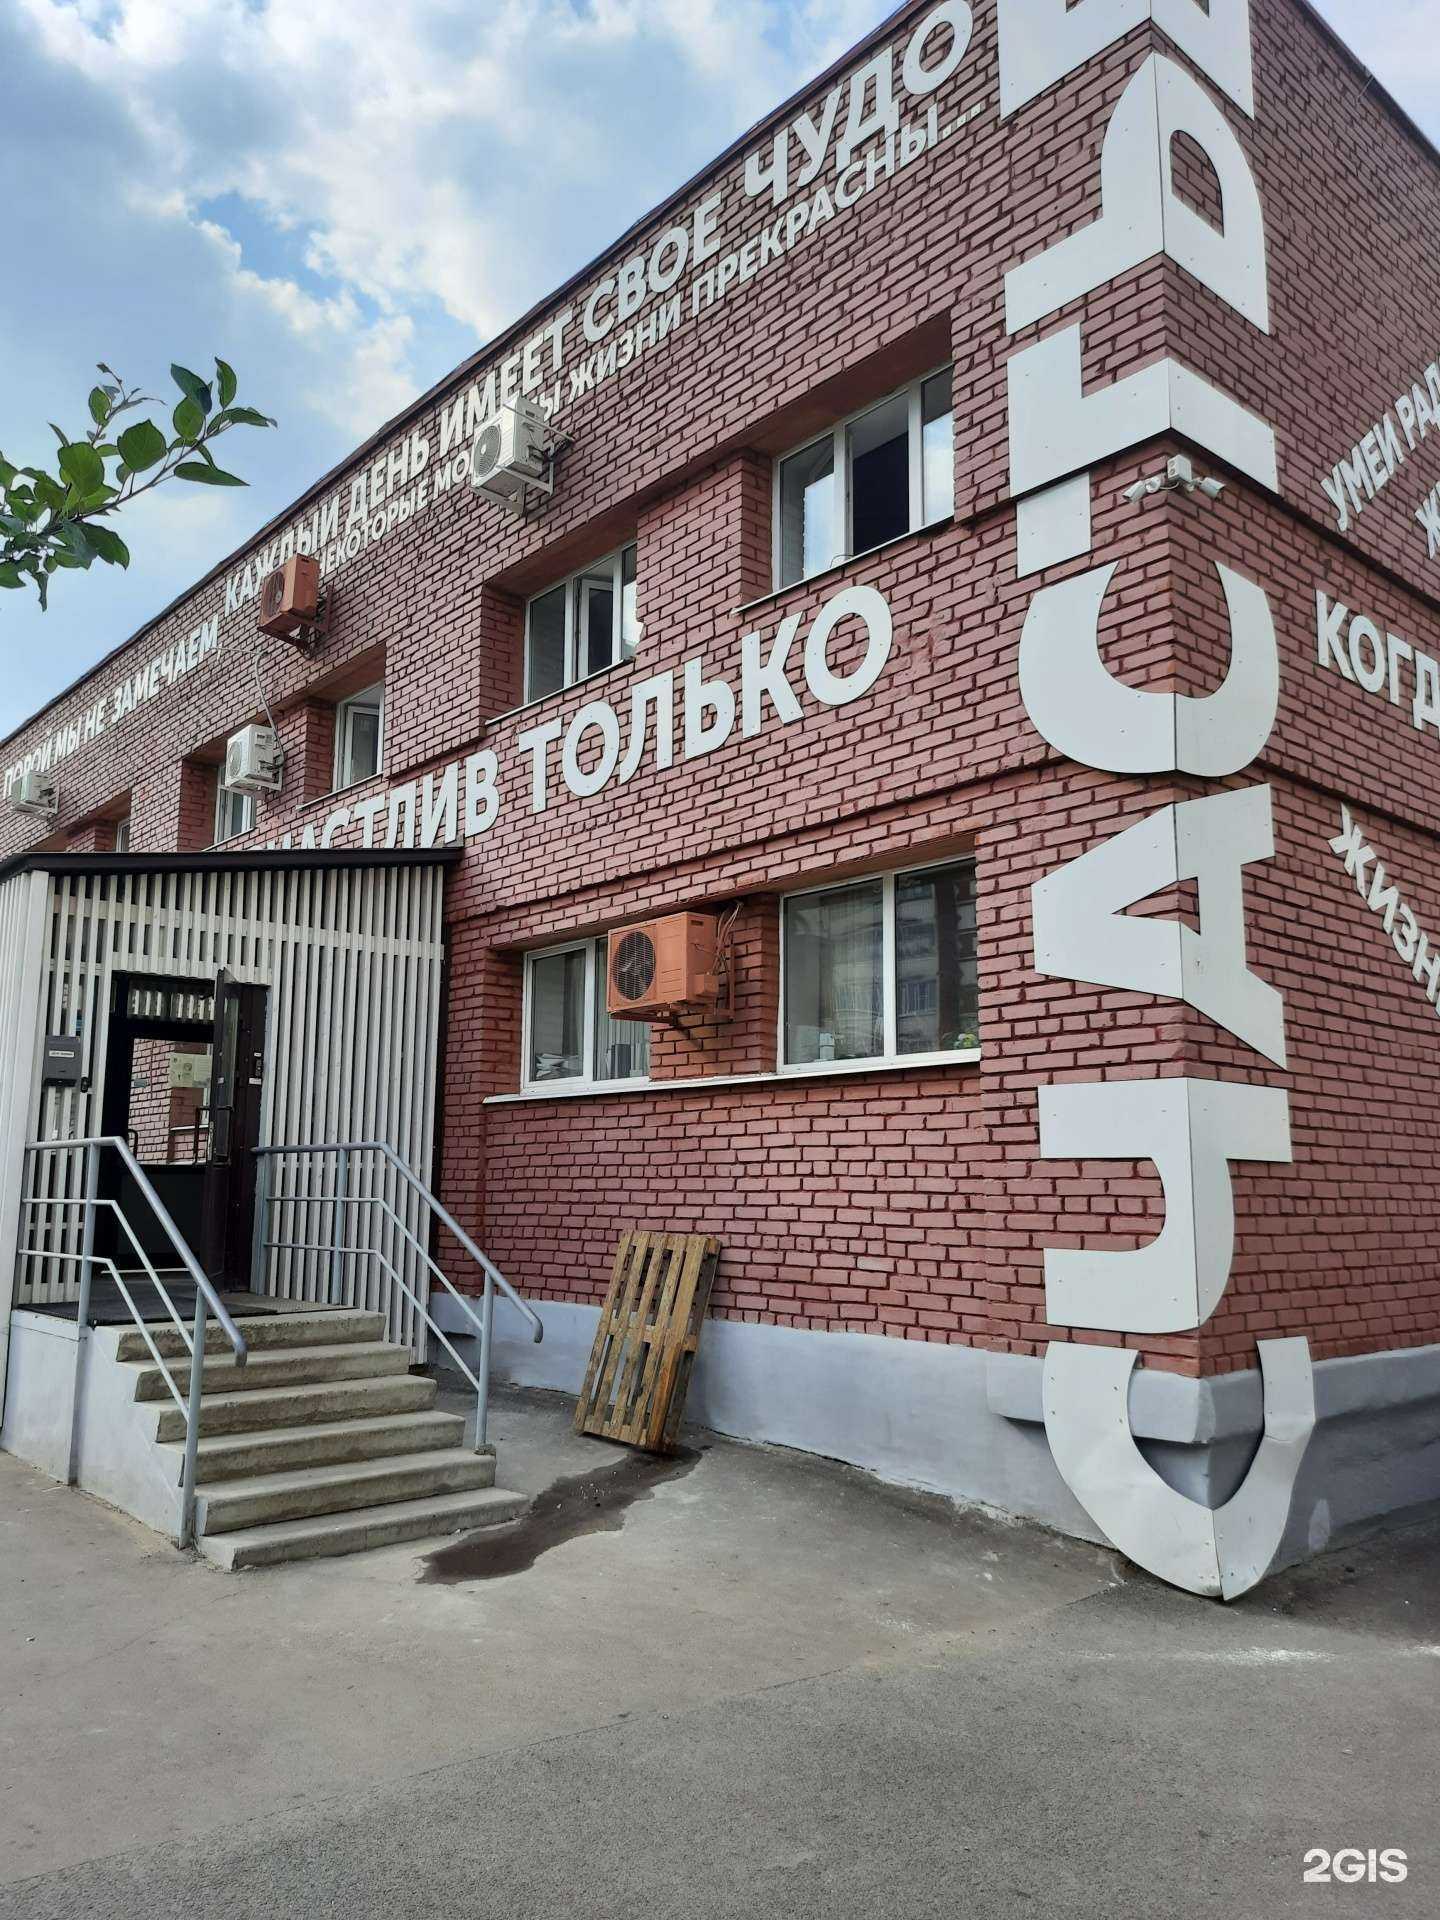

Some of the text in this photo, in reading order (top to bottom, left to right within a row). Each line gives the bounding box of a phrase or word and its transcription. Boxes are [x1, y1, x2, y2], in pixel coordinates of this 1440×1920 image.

[345, 429, 430, 536] ДЕНЬ
[440, 305, 574, 458] ИМЕЕТ
[582, 191, 723, 343] СВОЕ
[744, 0, 974, 206] ЧУДО
[54, 715, 83, 764] МЫ
[84, 698, 108, 744] НЕ
[566, 293, 681, 404] ЖИЗНИ
[518, 585, 893, 813] ТОЛЬКО
[1315, 588, 1440, 738] КОГД
[1327, 802, 1440, 1017] ЖИЗН
